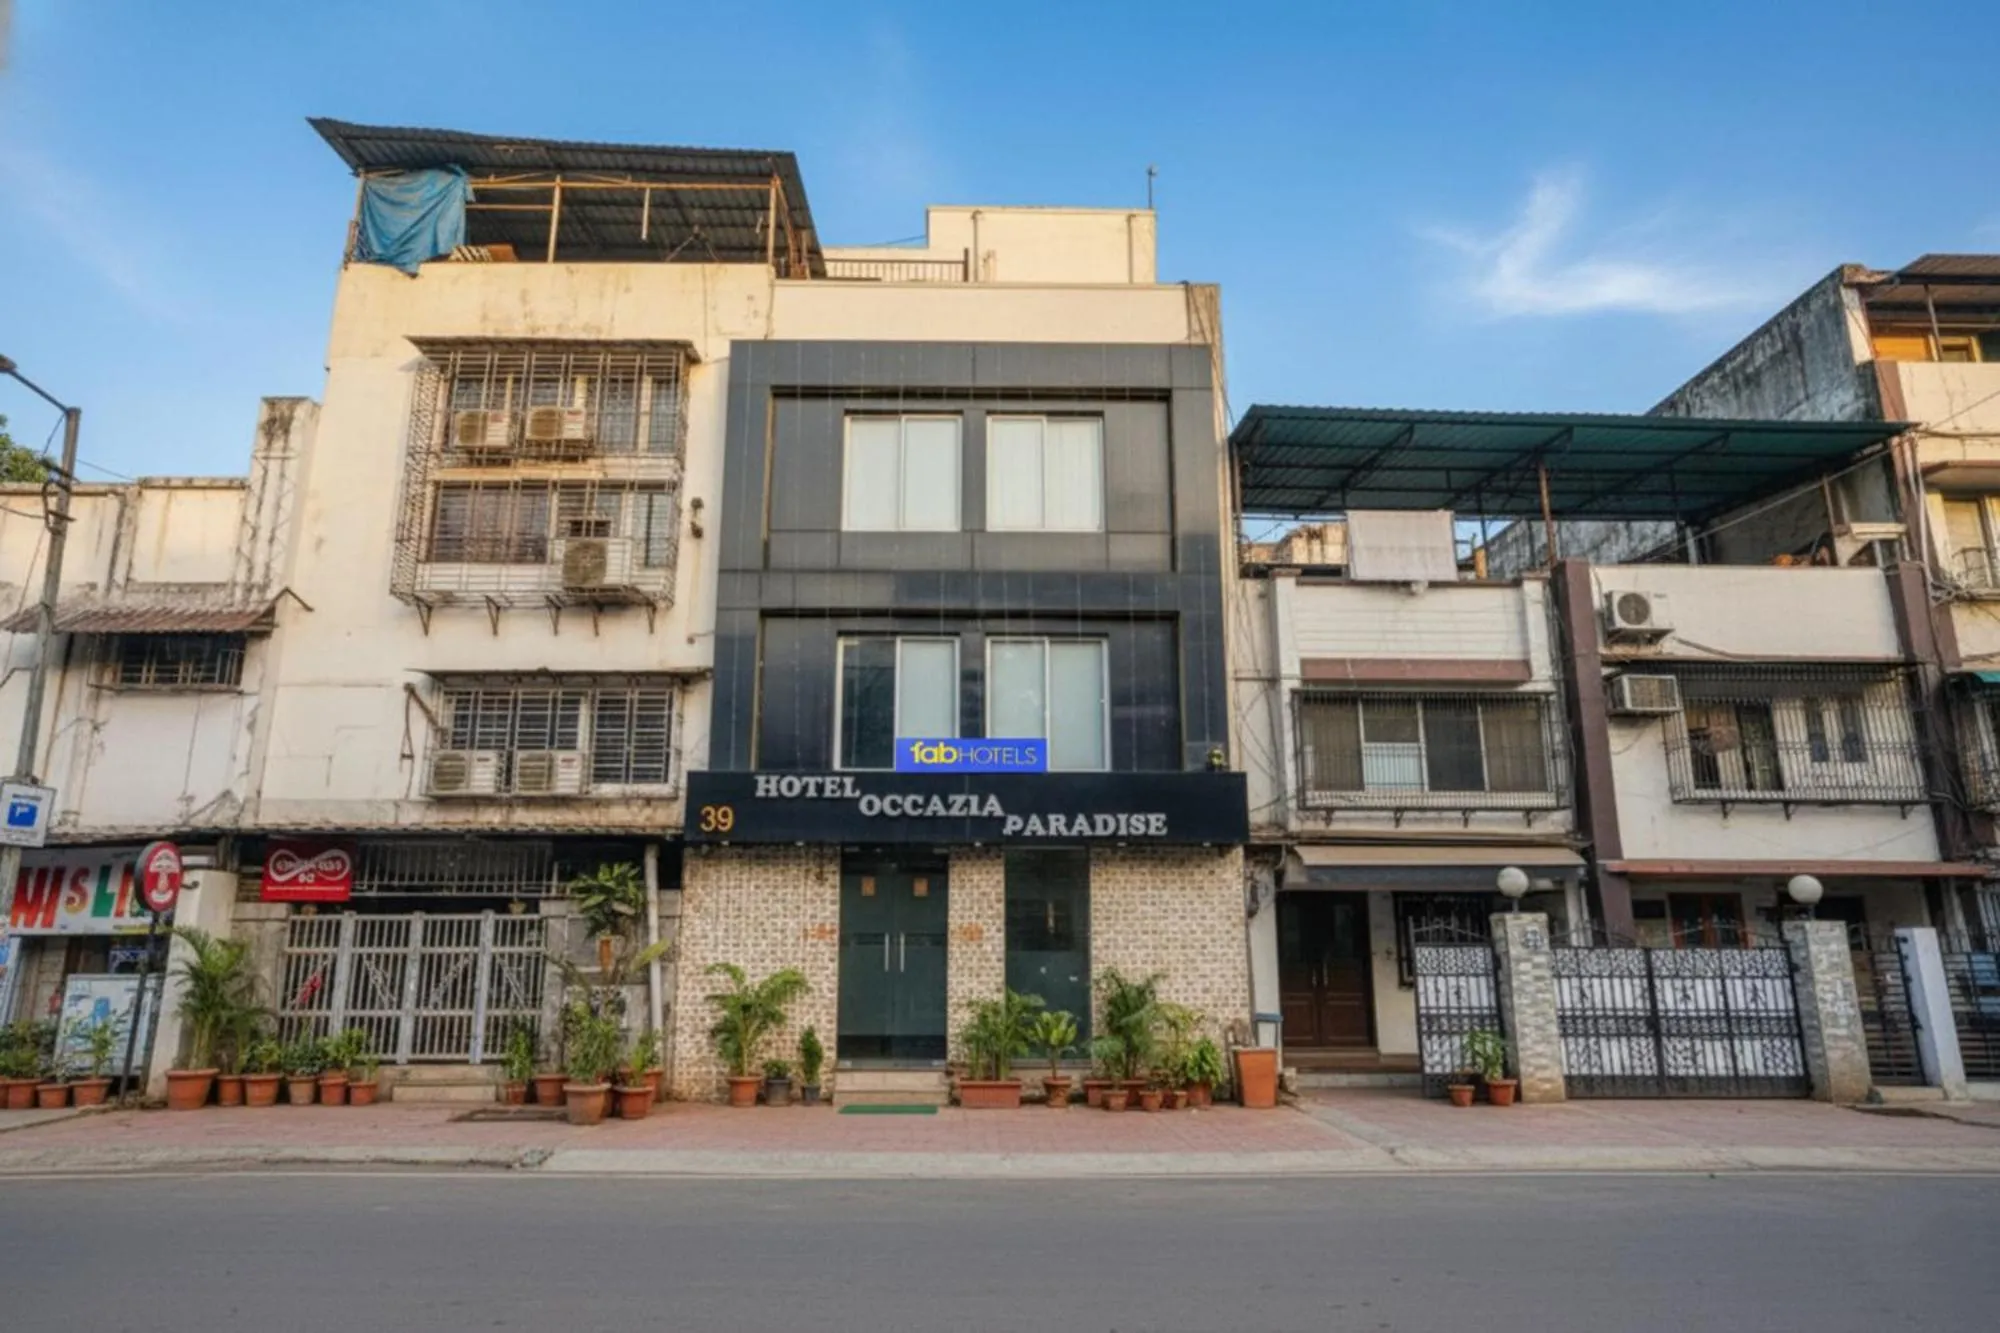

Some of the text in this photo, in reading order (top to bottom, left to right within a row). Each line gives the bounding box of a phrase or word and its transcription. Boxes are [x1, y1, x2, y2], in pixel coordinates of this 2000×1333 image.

[911, 741, 1037, 765] fabHOTELS
[700, 806, 734, 832] 39
[754, 775, 1168, 837] HOTEL OCCAZIA PARADISE
